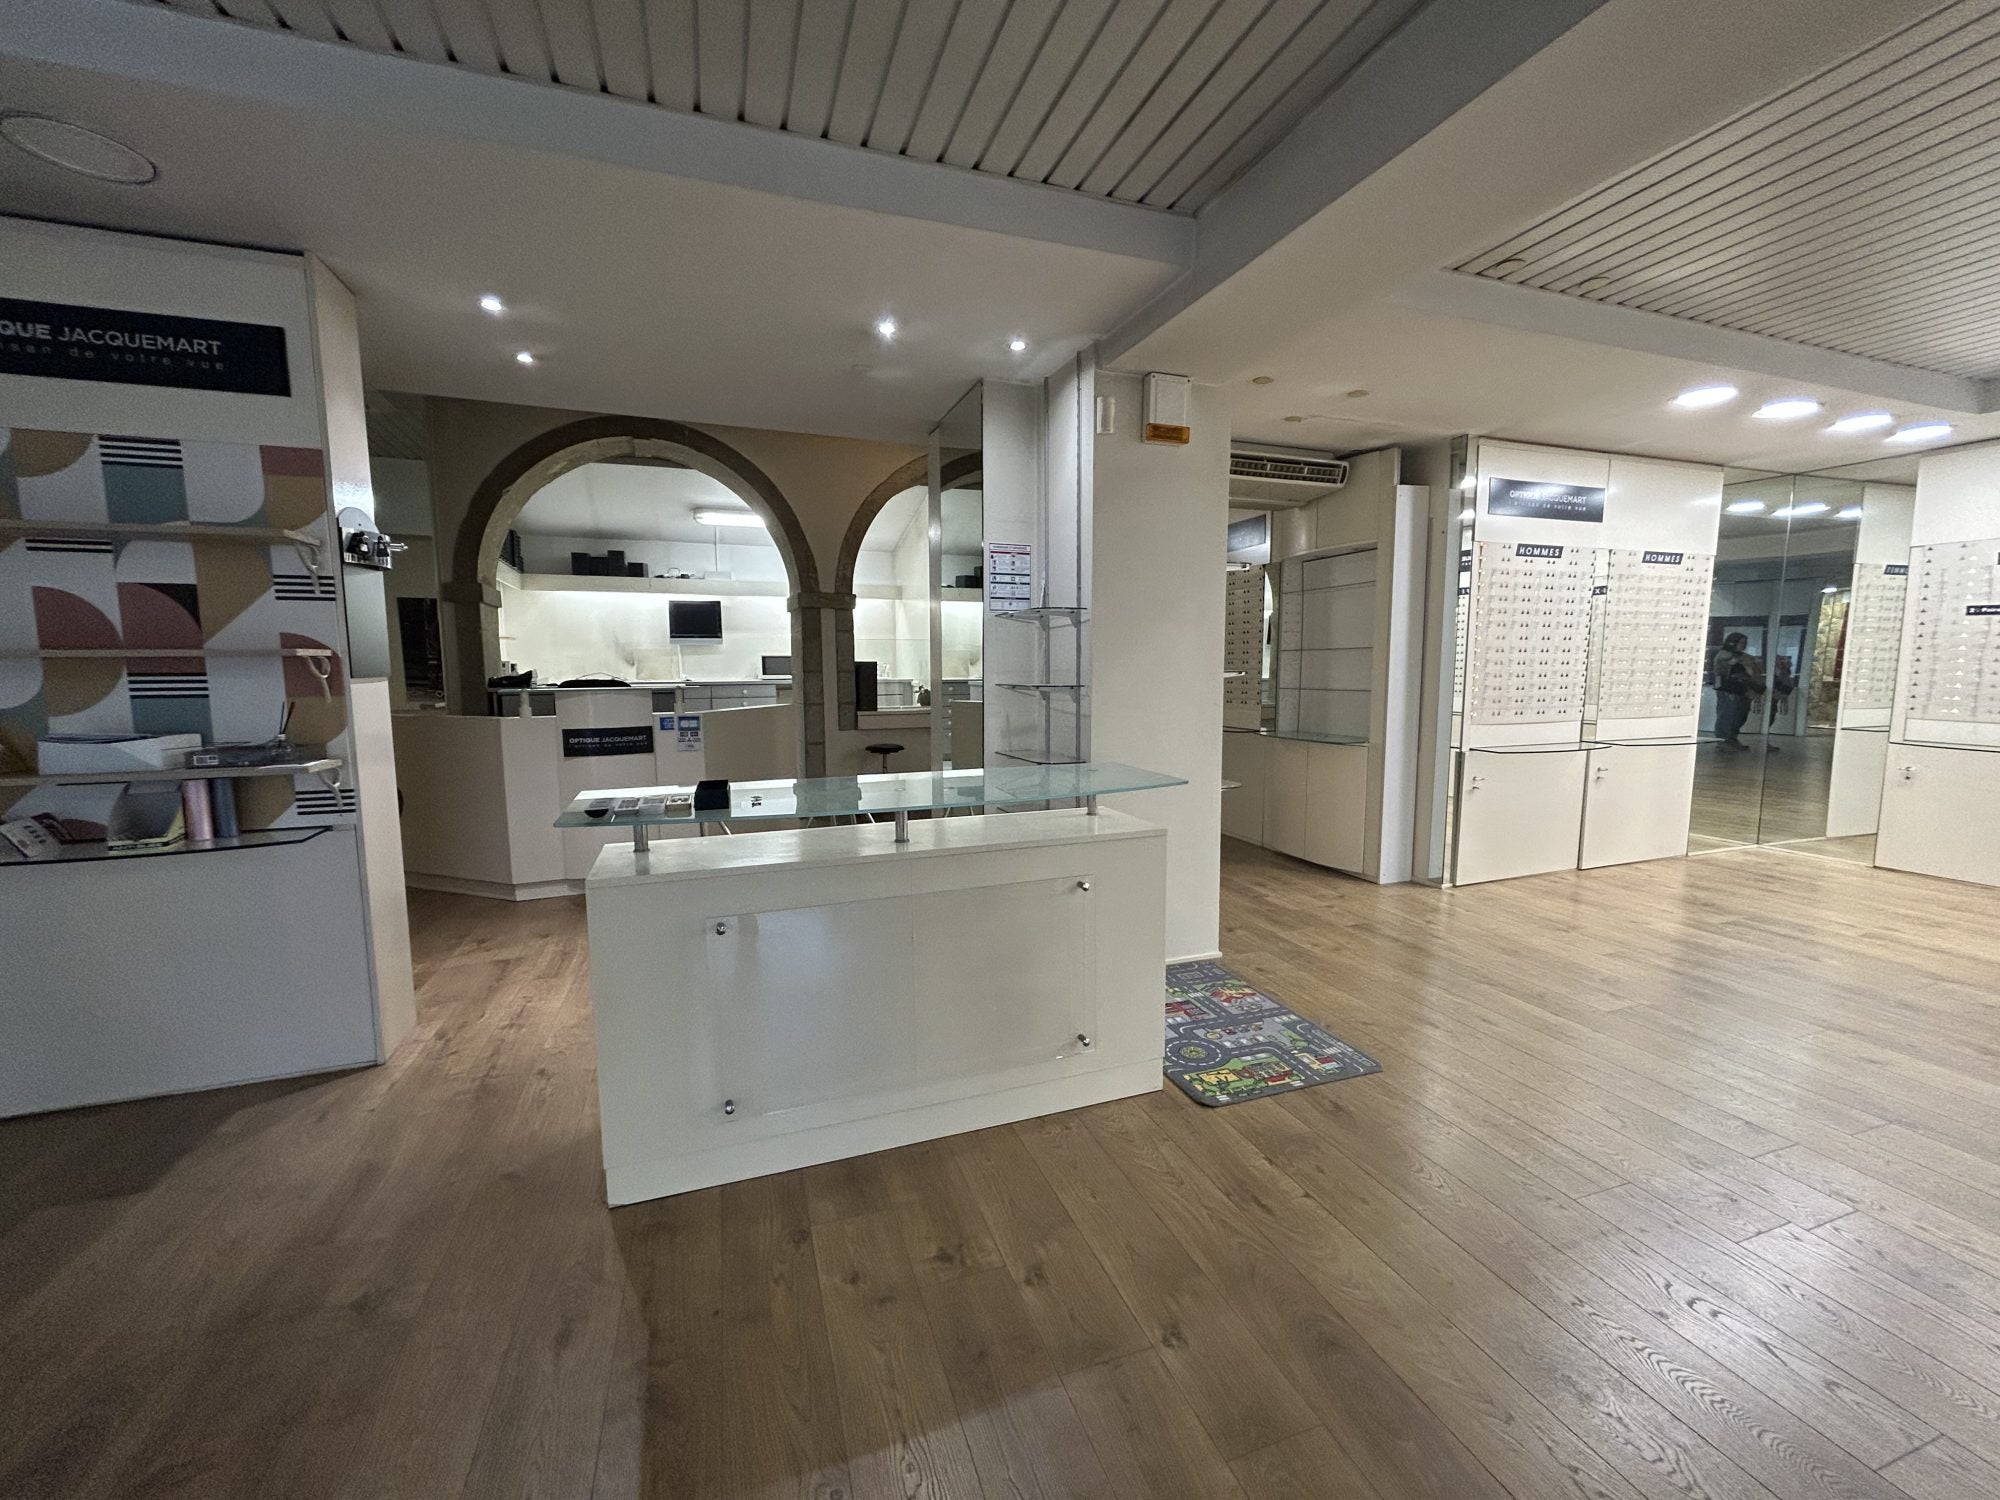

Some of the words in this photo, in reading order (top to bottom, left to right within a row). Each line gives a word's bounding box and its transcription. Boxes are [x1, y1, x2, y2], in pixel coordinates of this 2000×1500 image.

[58, 326, 222, 356] JACQUEMART
[69, 346, 94, 359] de
[111, 350, 171, 366] votre
[188, 358, 224, 370] vue
[1519, 546, 1560, 557] HOMMES
[1644, 553, 1681, 563] HOMMES
[601, 735, 647, 743] JACQUEMART
